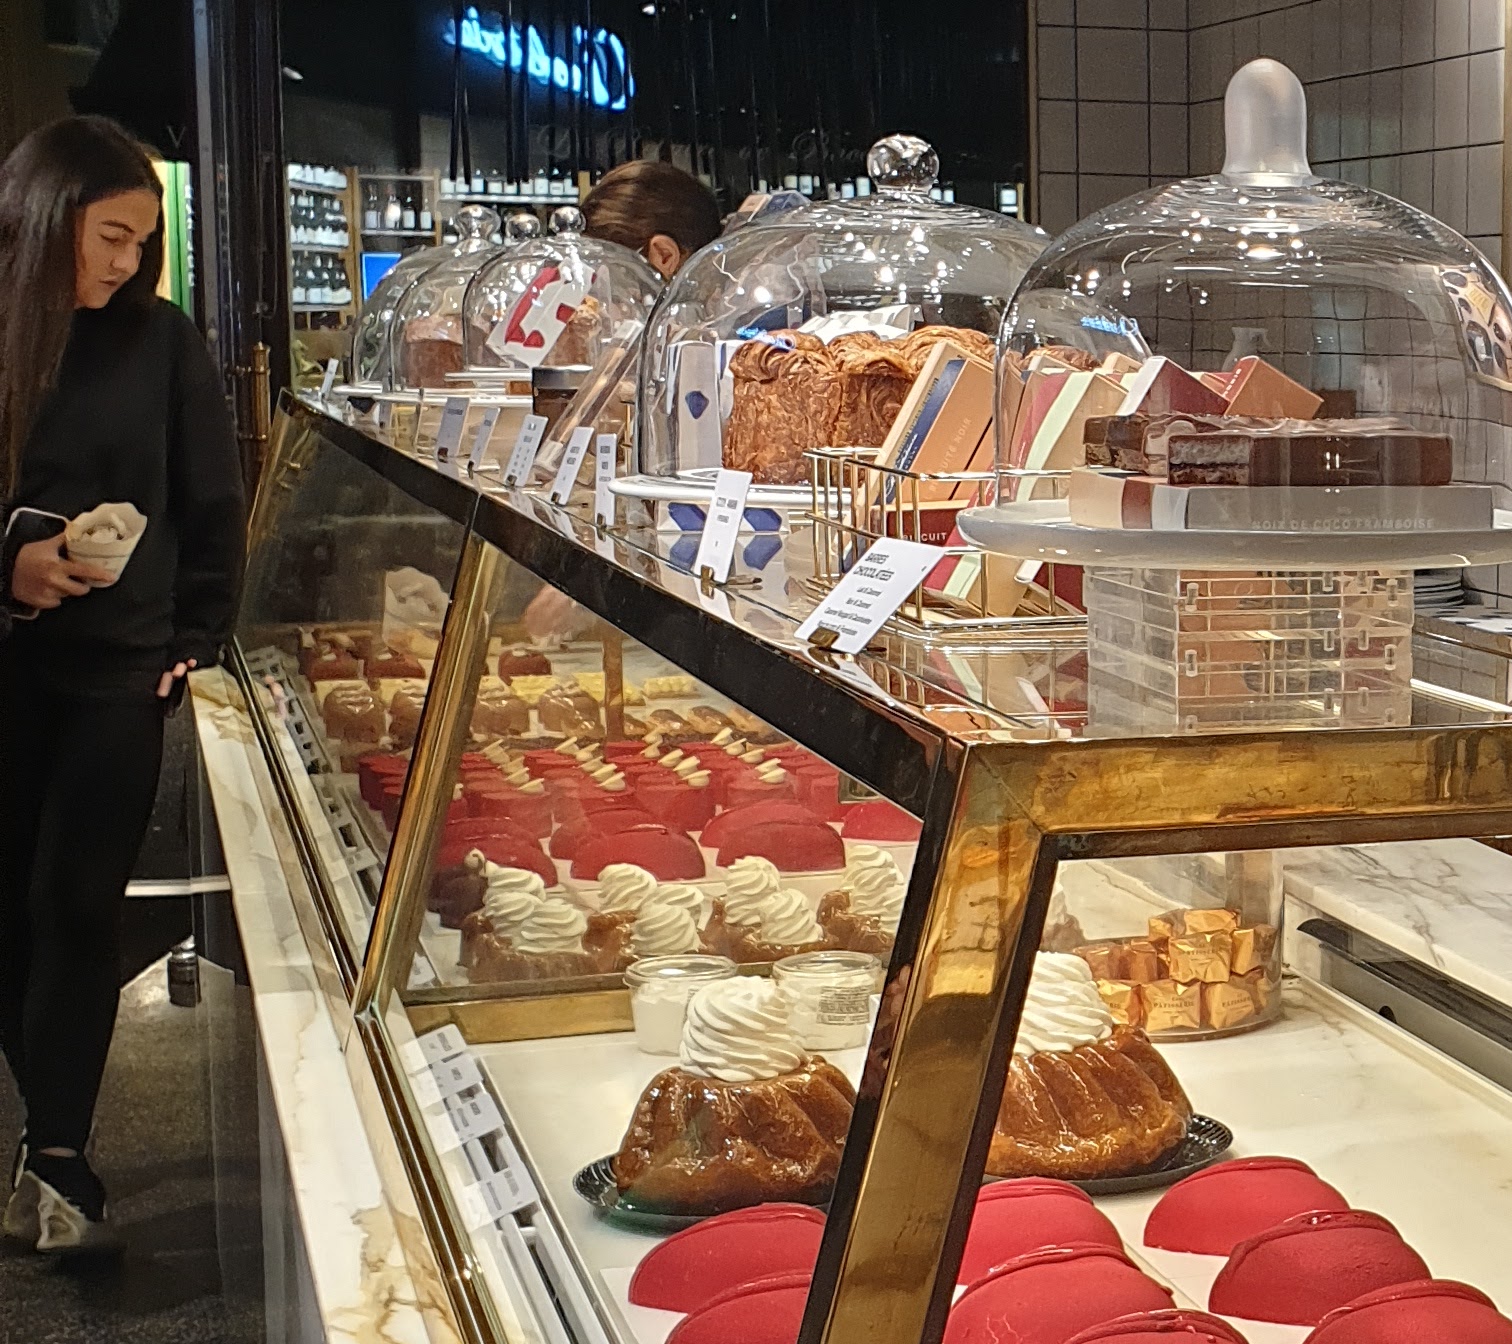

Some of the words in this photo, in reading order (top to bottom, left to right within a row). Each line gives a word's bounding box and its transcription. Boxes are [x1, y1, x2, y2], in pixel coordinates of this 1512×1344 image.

[954, 418, 971, 443] NOIR
[1252, 519, 1285, 530] NOIX
[1289, 520, 1307, 530] DE
[1312, 519, 1350, 530] COCO
[1356, 518, 1435, 530] FRAMBOISE
[903, 532, 947, 542] BICUIT
